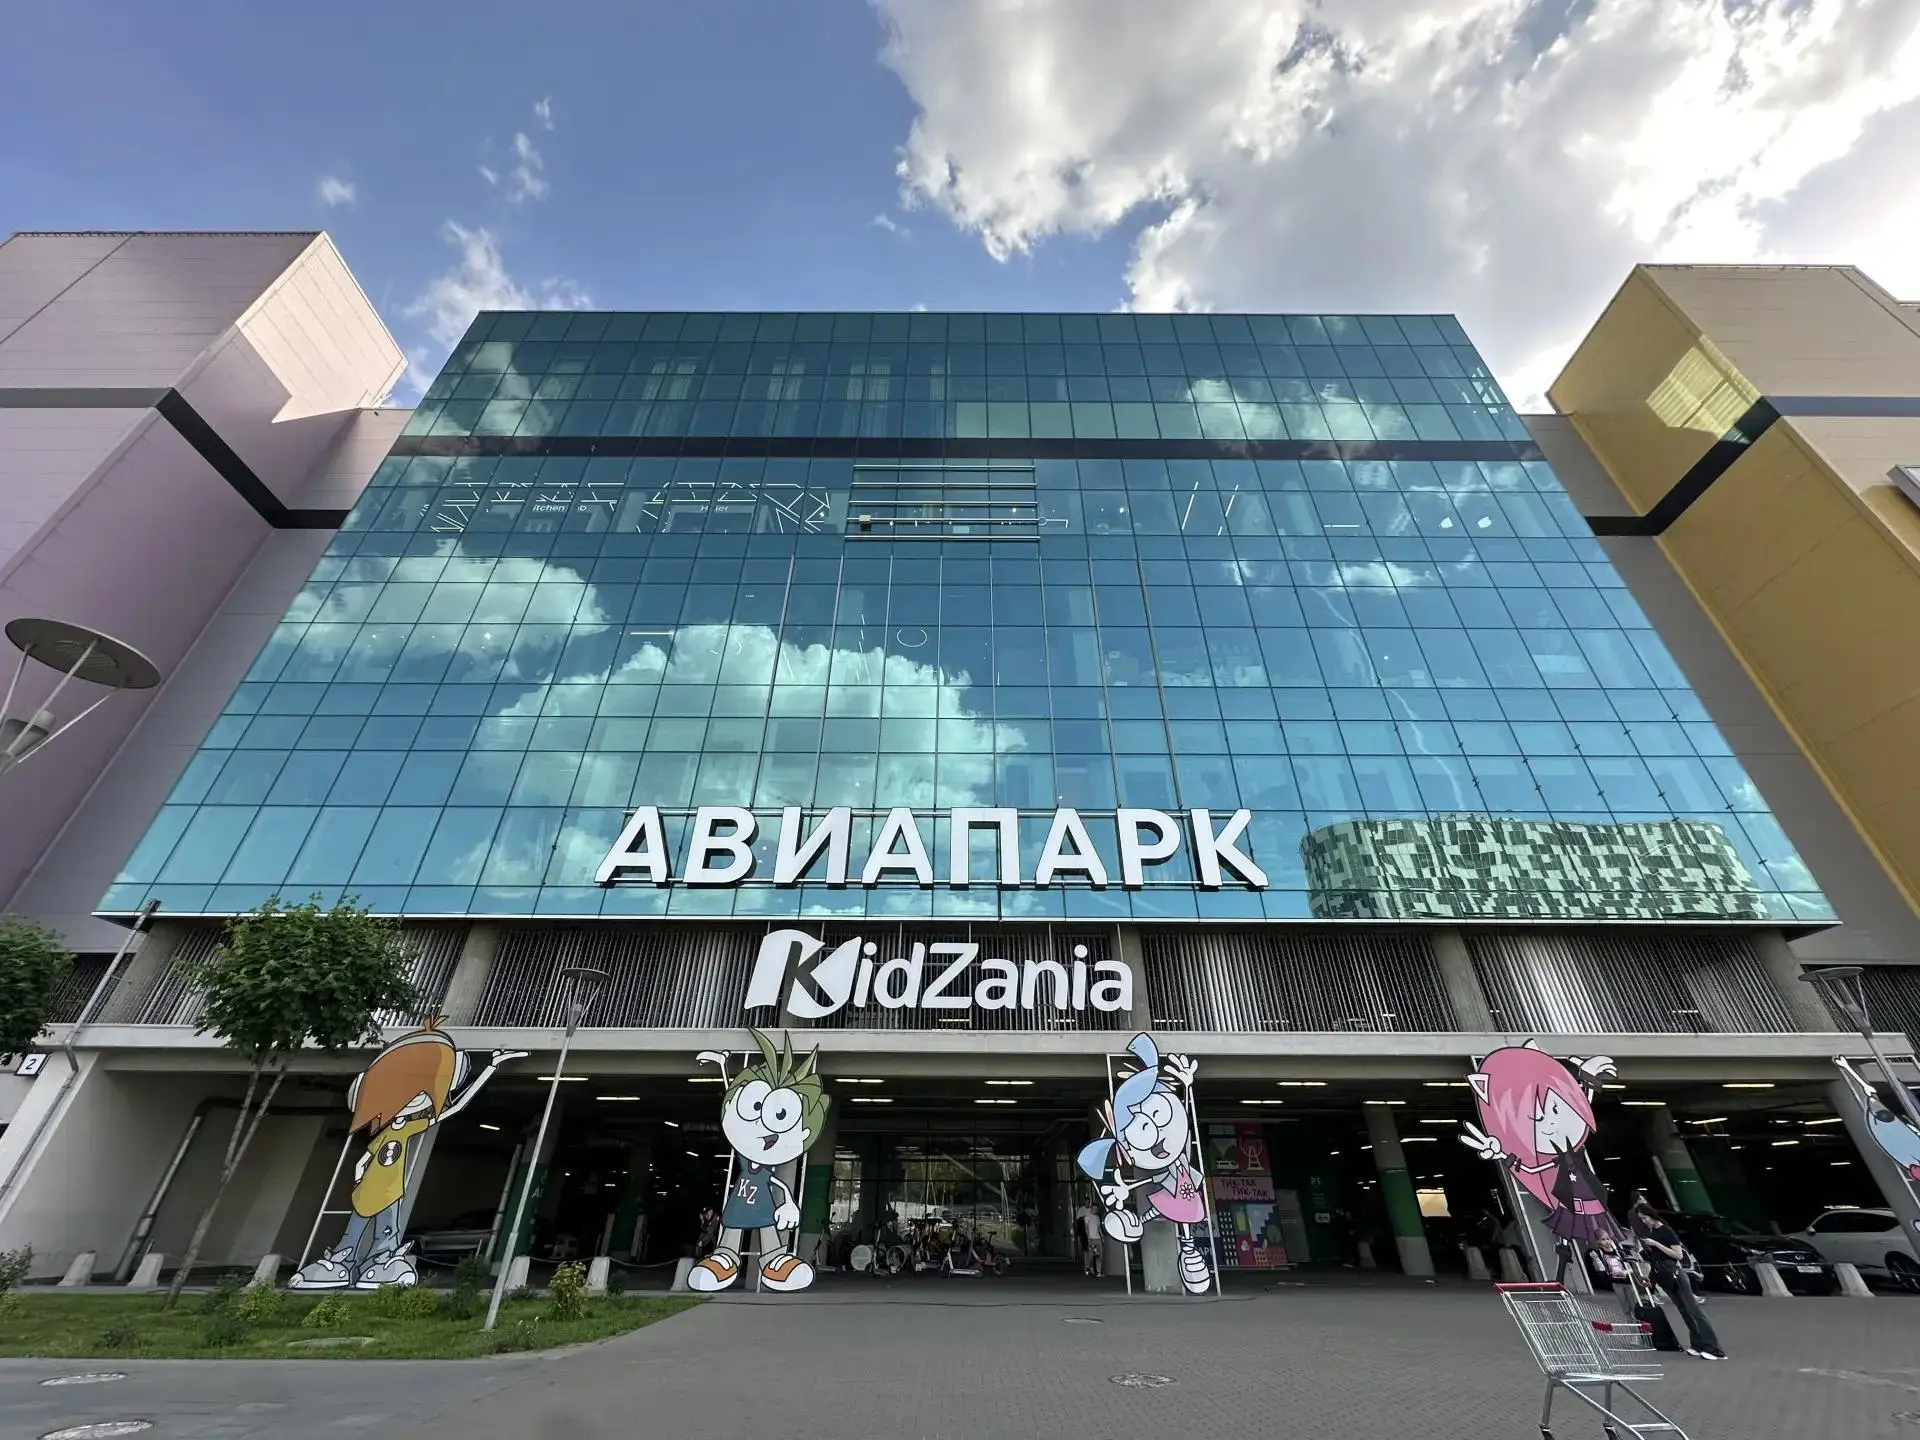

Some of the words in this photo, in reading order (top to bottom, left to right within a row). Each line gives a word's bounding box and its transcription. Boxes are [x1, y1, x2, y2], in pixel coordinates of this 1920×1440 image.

[594, 805, 1269, 889] АВИАПАРК
[743, 928, 1133, 1019] KidZania
[25, 1059, 37, 1070] 2
[737, 1178, 758, 1205] KZ
